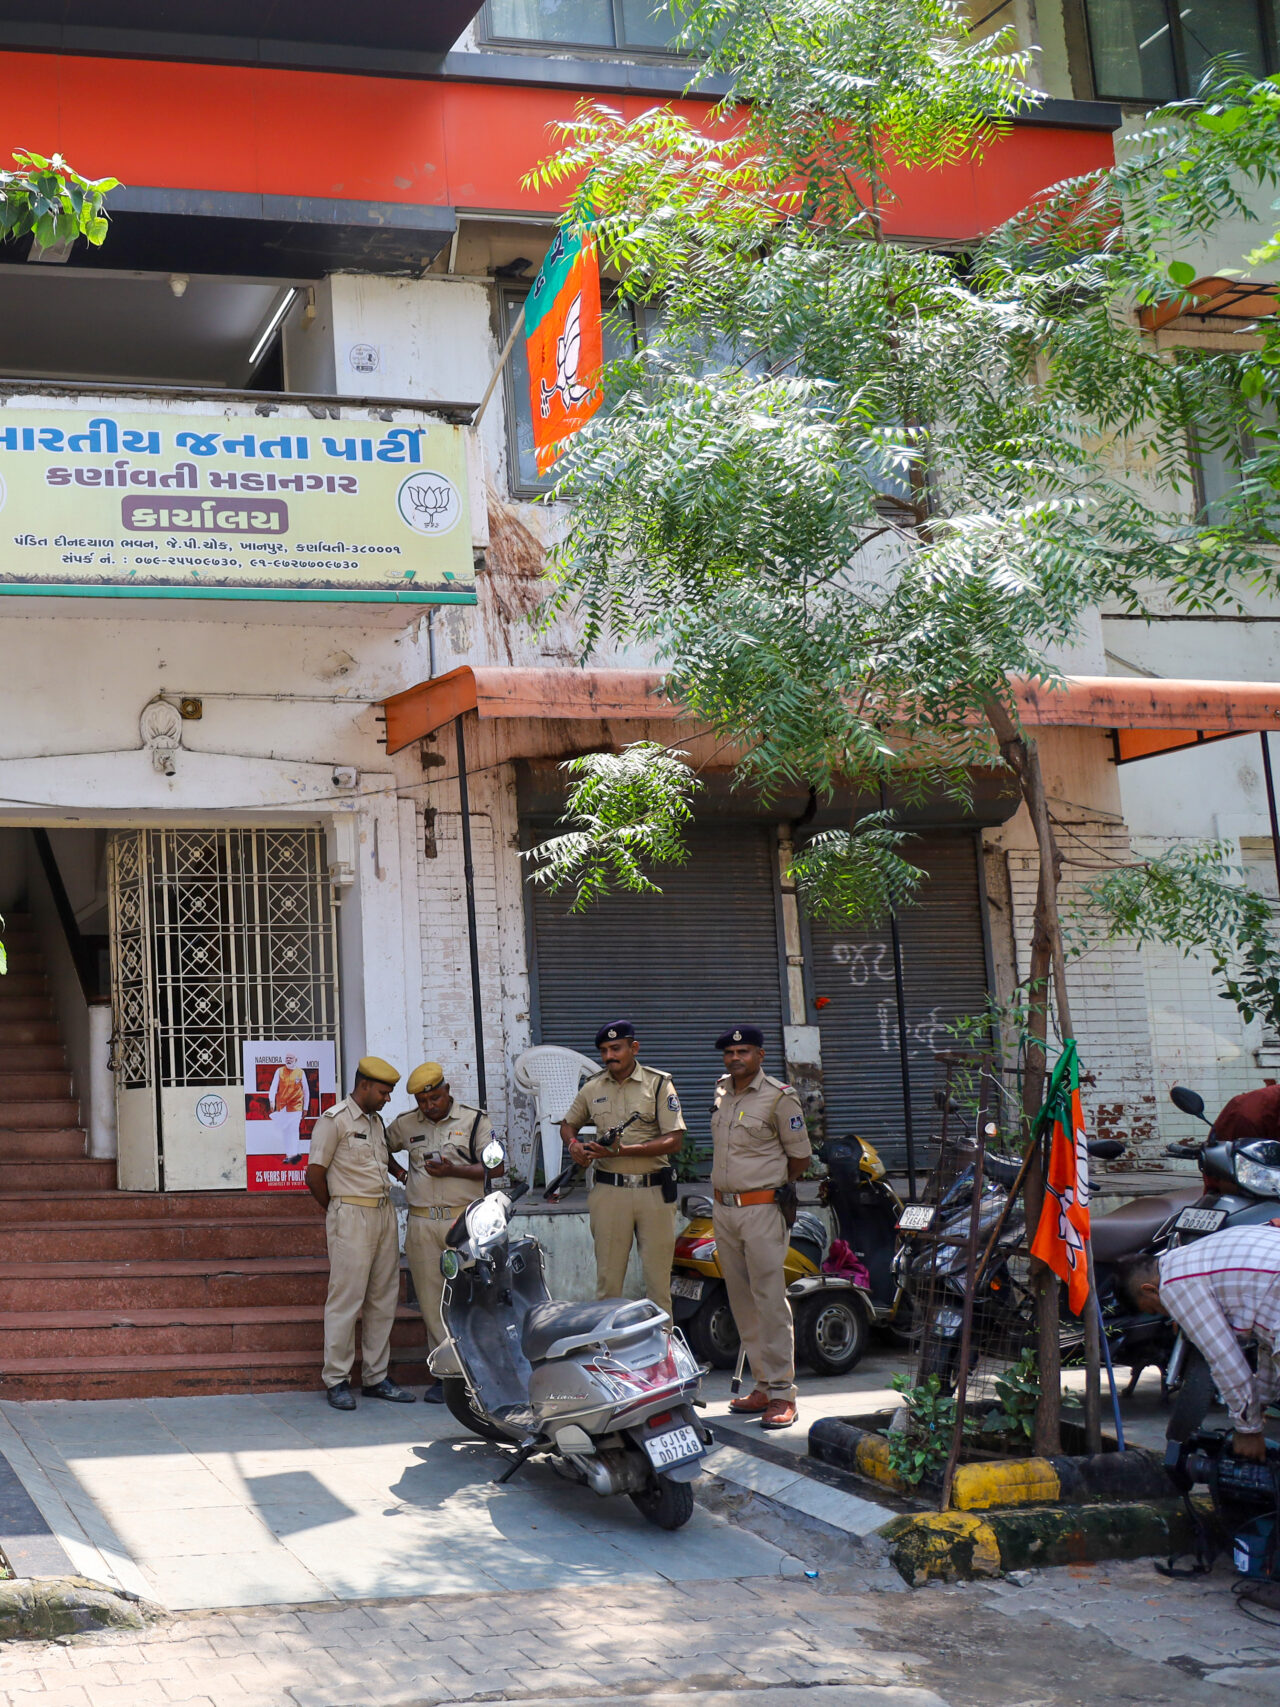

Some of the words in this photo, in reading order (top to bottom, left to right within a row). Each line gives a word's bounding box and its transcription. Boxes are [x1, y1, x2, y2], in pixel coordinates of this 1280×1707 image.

[176, 432, 309, 459] જનતા
[322, 428, 426, 463] પાર્ટી
[46, 460, 198, 489] કર્ણાવતી
[209, 472, 357, 494] મહાનગર
[132, 500, 280, 530] કાર્યાલય
[14, 534, 47, 546] પંડિત
[54, 535, 114, 548] દીનદયાળ
[121, 540, 158, 550] ભવન,
[240, 542, 287, 554] ખાનપુર,
[62, 552, 95, 564] સંપર્ક
